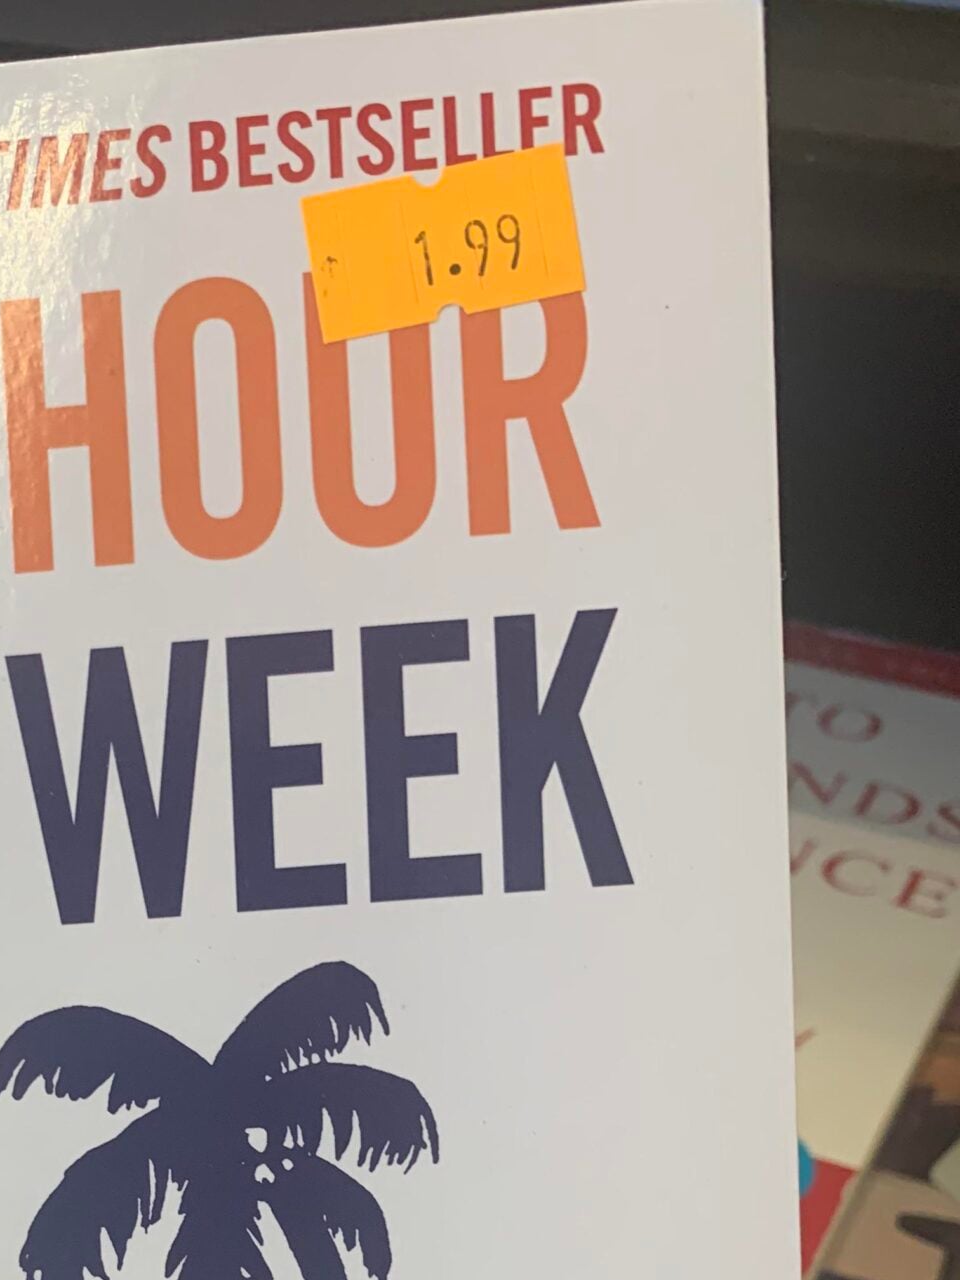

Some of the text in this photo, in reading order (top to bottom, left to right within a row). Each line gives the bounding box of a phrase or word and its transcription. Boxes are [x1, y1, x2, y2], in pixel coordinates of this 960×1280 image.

[188, 82, 605, 194] BESTSELLER
[413, 213, 522, 286] 1.99
[4, 607, 635, 926] WEEK
